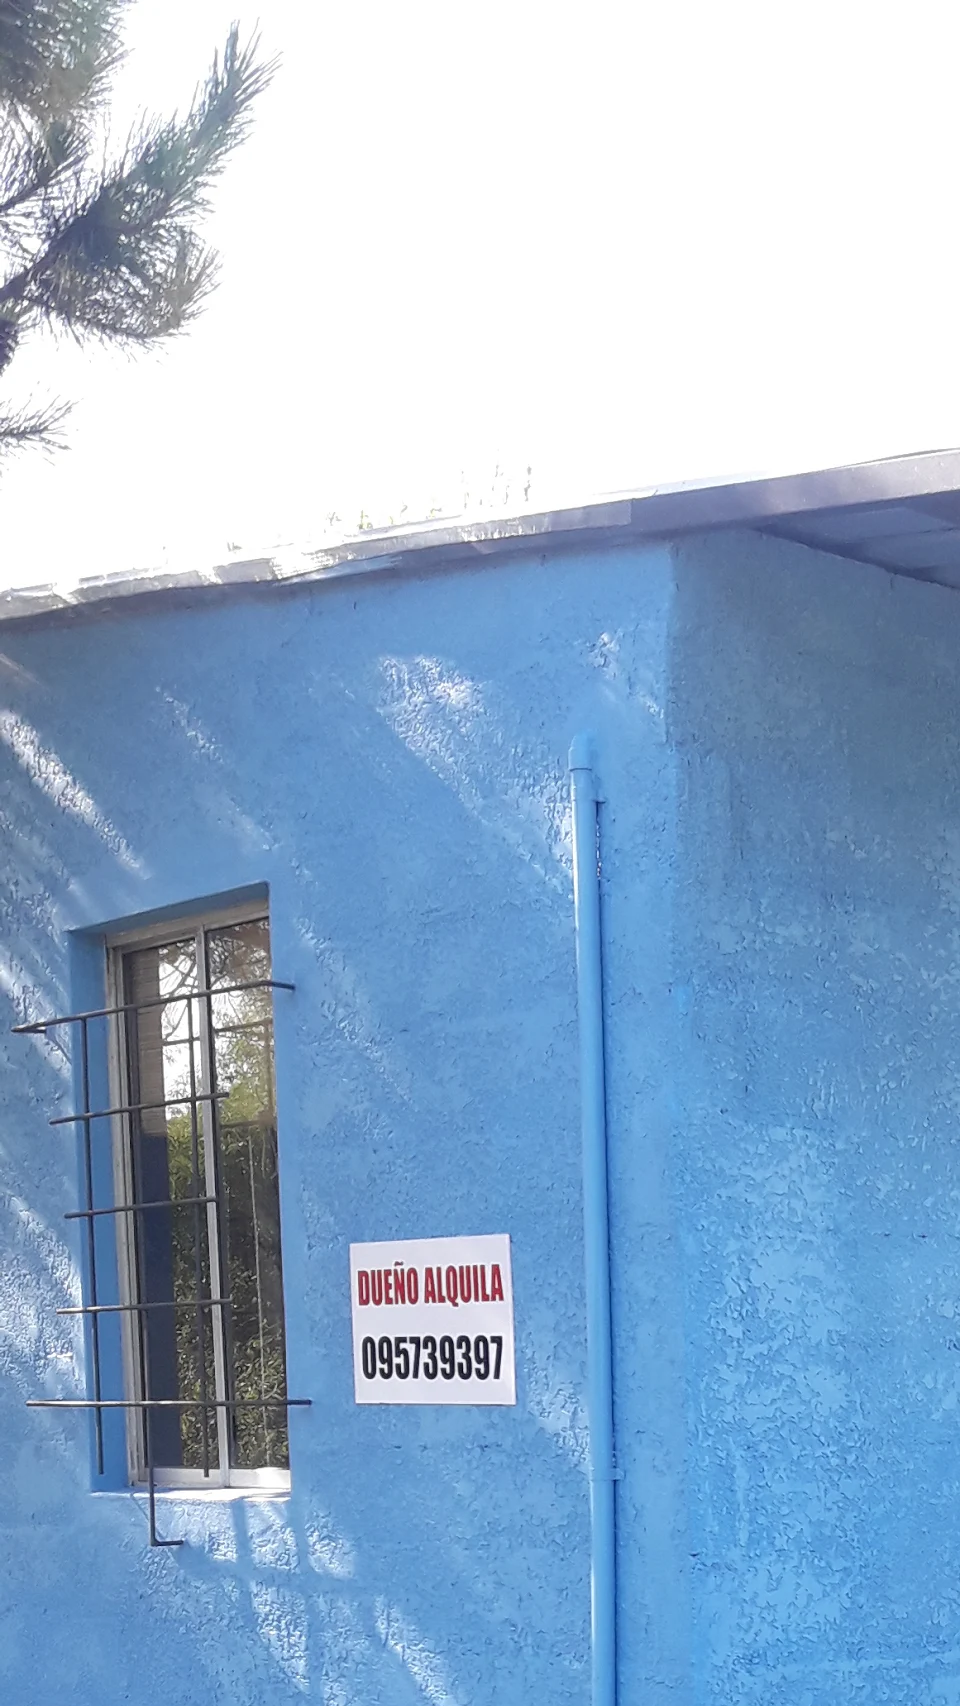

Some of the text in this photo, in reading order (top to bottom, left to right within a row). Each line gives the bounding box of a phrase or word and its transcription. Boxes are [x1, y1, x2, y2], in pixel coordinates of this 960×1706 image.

[357, 1261, 504, 1307] DUEÑO ALQUILA
[361, 1335, 503, 1380] 095739397
